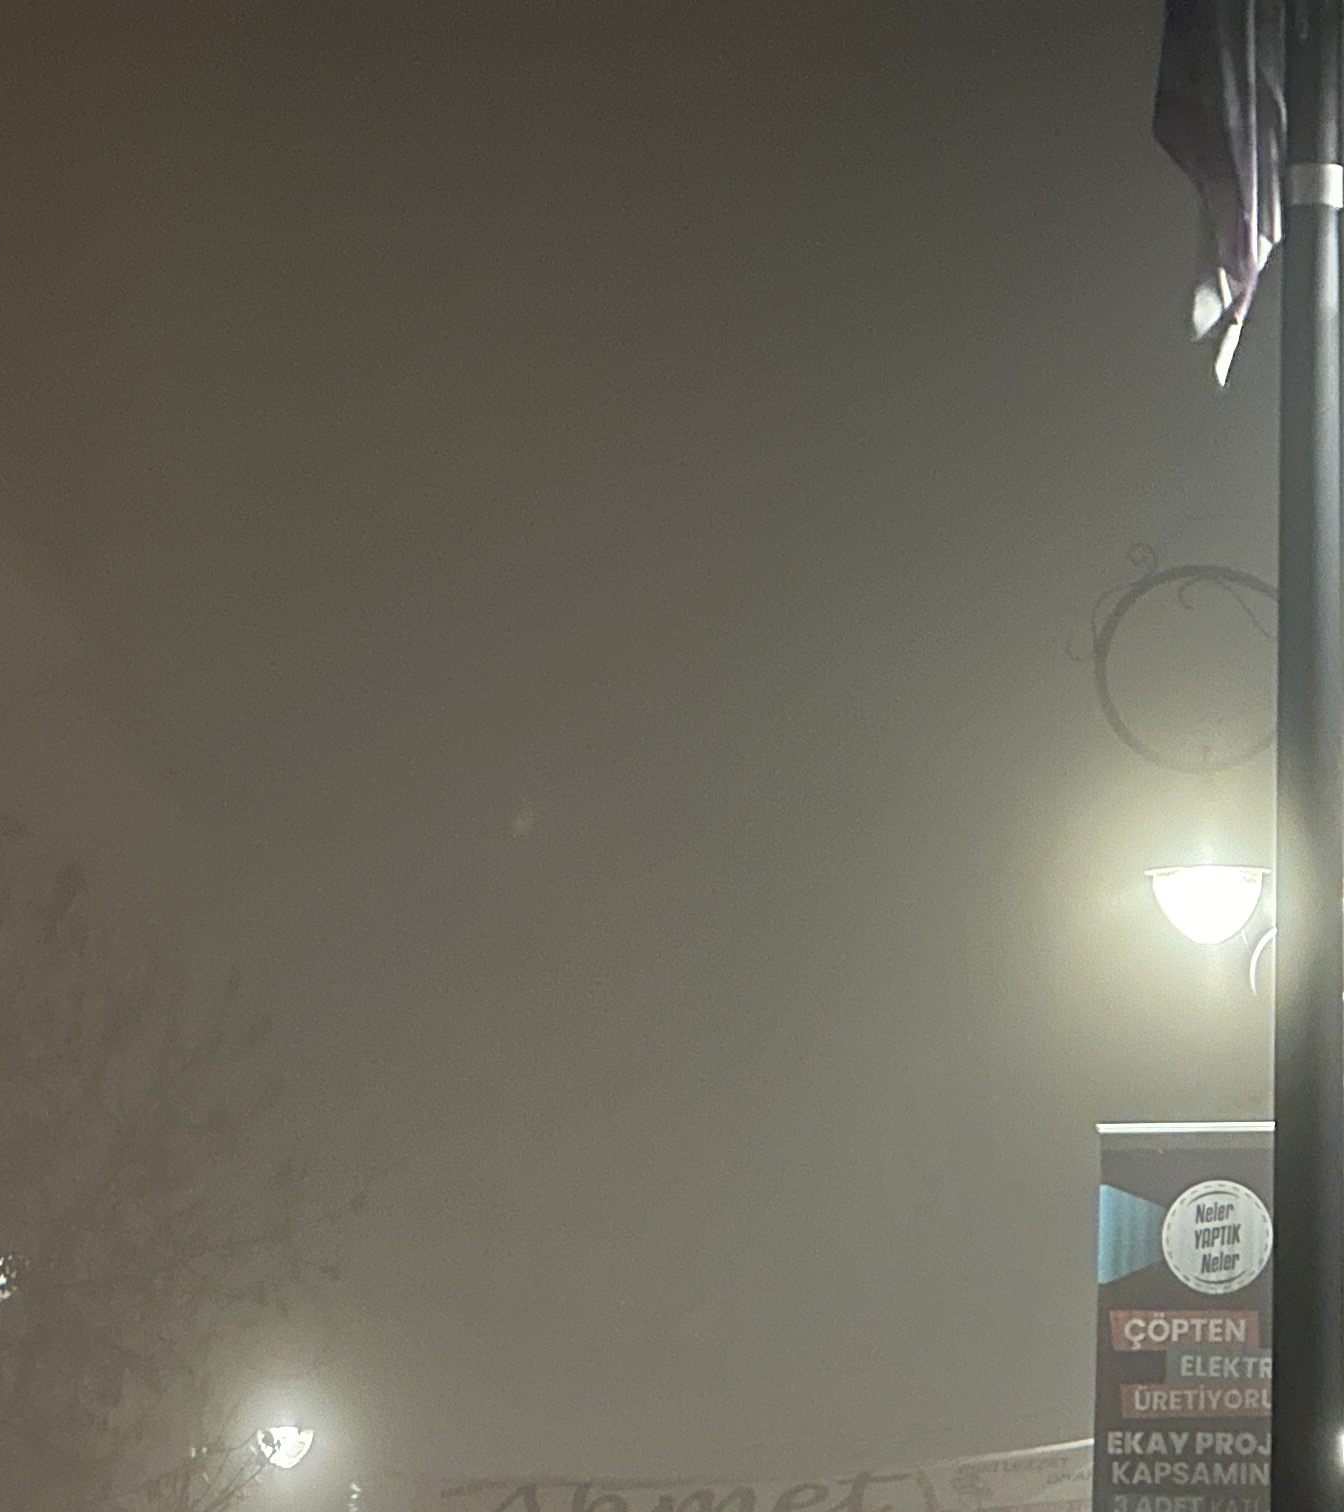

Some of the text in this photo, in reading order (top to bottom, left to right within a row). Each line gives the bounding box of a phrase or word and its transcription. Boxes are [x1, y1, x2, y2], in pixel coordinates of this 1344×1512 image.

[1195, 1202, 1234, 1225] Neler
[1194, 1223, 1241, 1250] YAPTIK
[1201, 1252, 1240, 1274] Neler
[1124, 1312, 1246, 1351] ÇÖPTEN
[1180, 1355, 1272, 1379] ELEKTR
[1107, 1430, 1271, 1456] EKAY PROJ
[1112, 1461, 1271, 1486] KAPSAMIN
